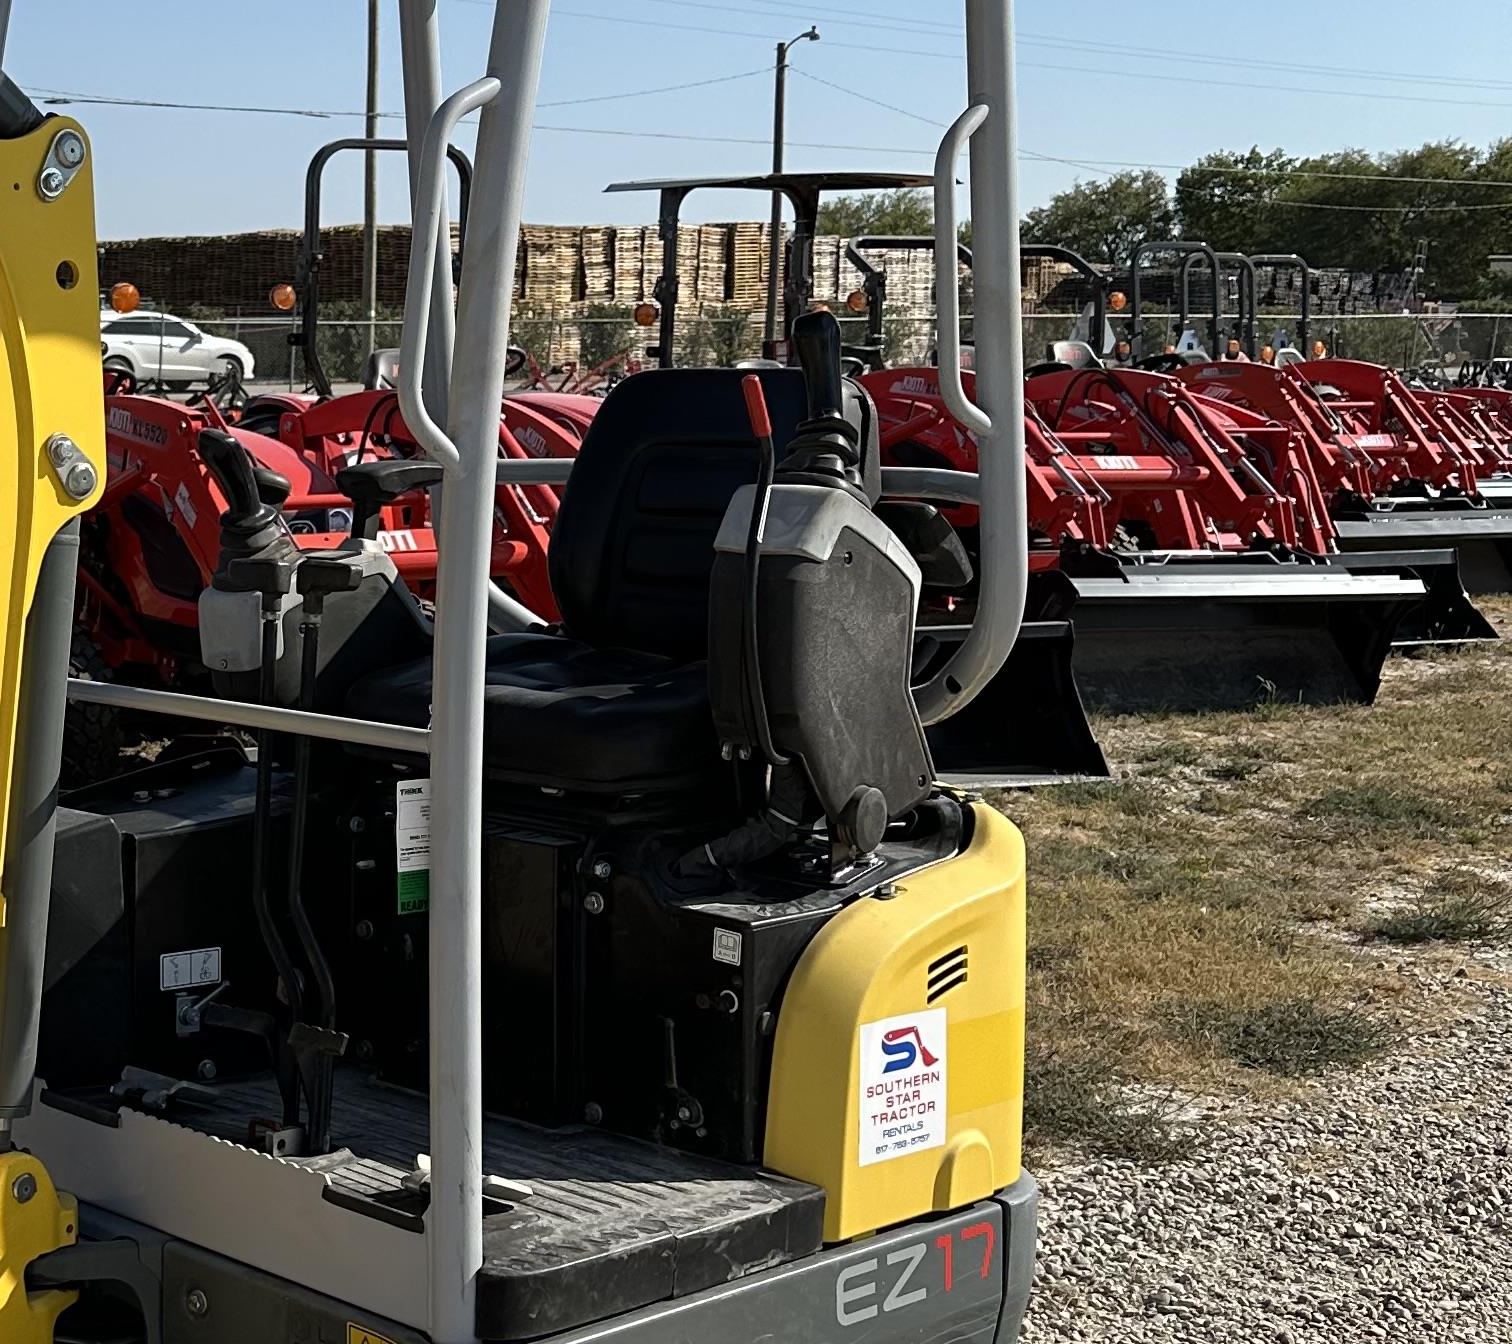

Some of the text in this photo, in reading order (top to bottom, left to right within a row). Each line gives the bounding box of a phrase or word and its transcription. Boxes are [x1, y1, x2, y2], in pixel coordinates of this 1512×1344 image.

[866, 1070, 941, 1099] SOUTHERN
[886, 1089, 921, 1108] STAR
[870, 1100, 936, 1126] TRACTOR
[882, 1120, 924, 1139] RENTALS
